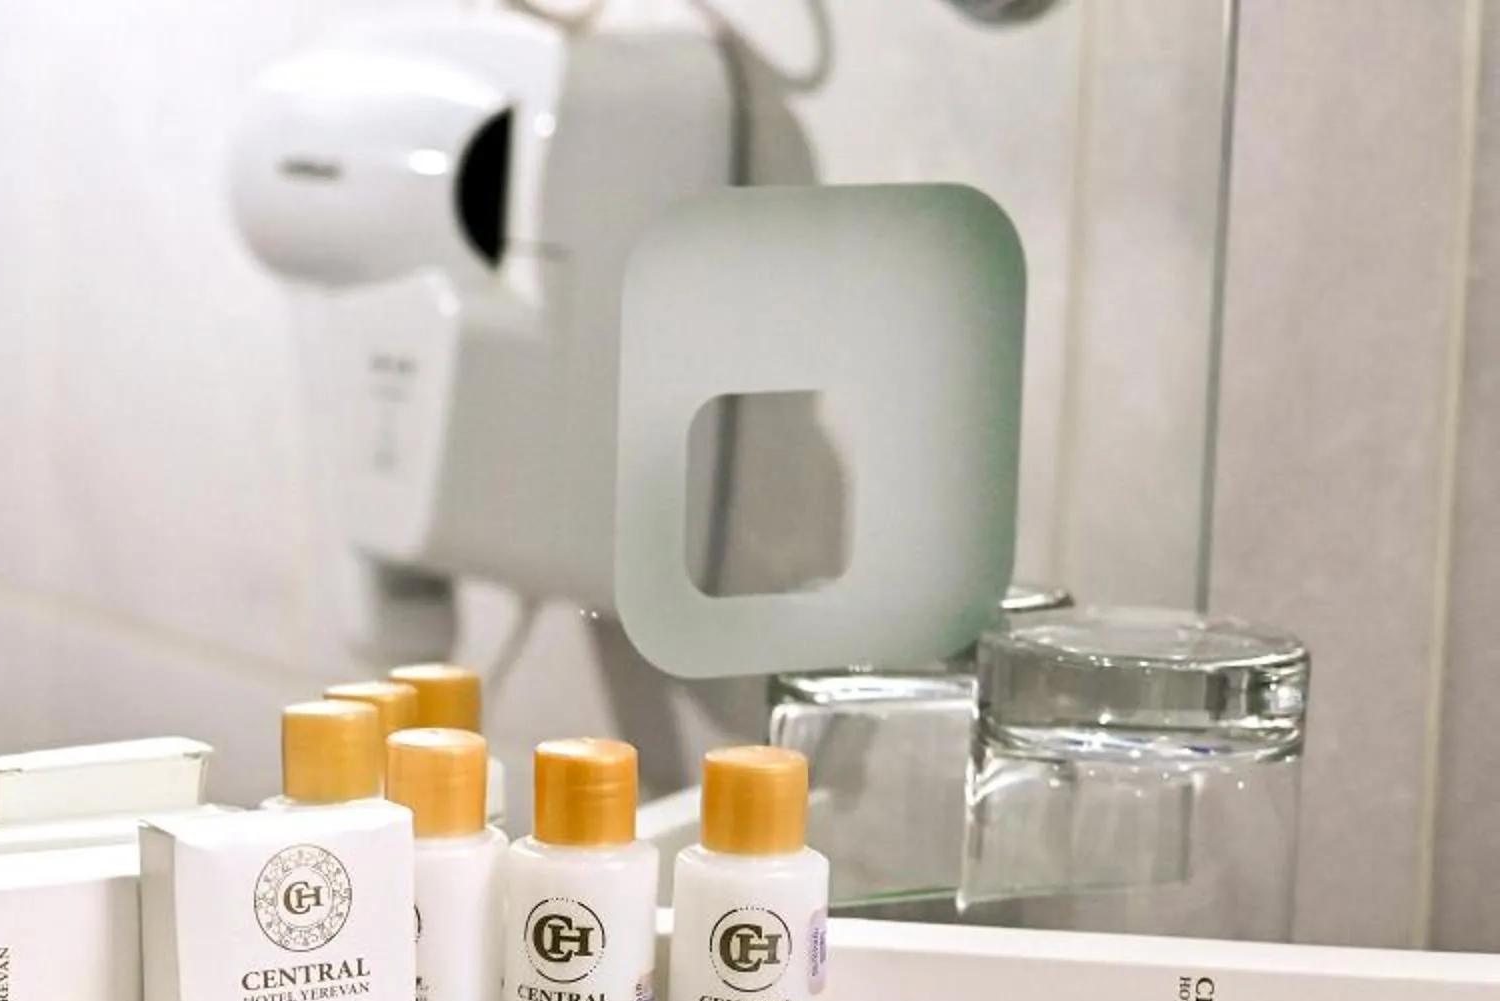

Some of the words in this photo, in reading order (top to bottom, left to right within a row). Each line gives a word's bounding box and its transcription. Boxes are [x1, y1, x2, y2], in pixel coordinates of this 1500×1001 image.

[532, 914, 595, 963] CH
[719, 923, 782, 972] CH
[241, 958, 371, 991] CENTRAL
[300, 982, 370, 1001] YEREVAN
